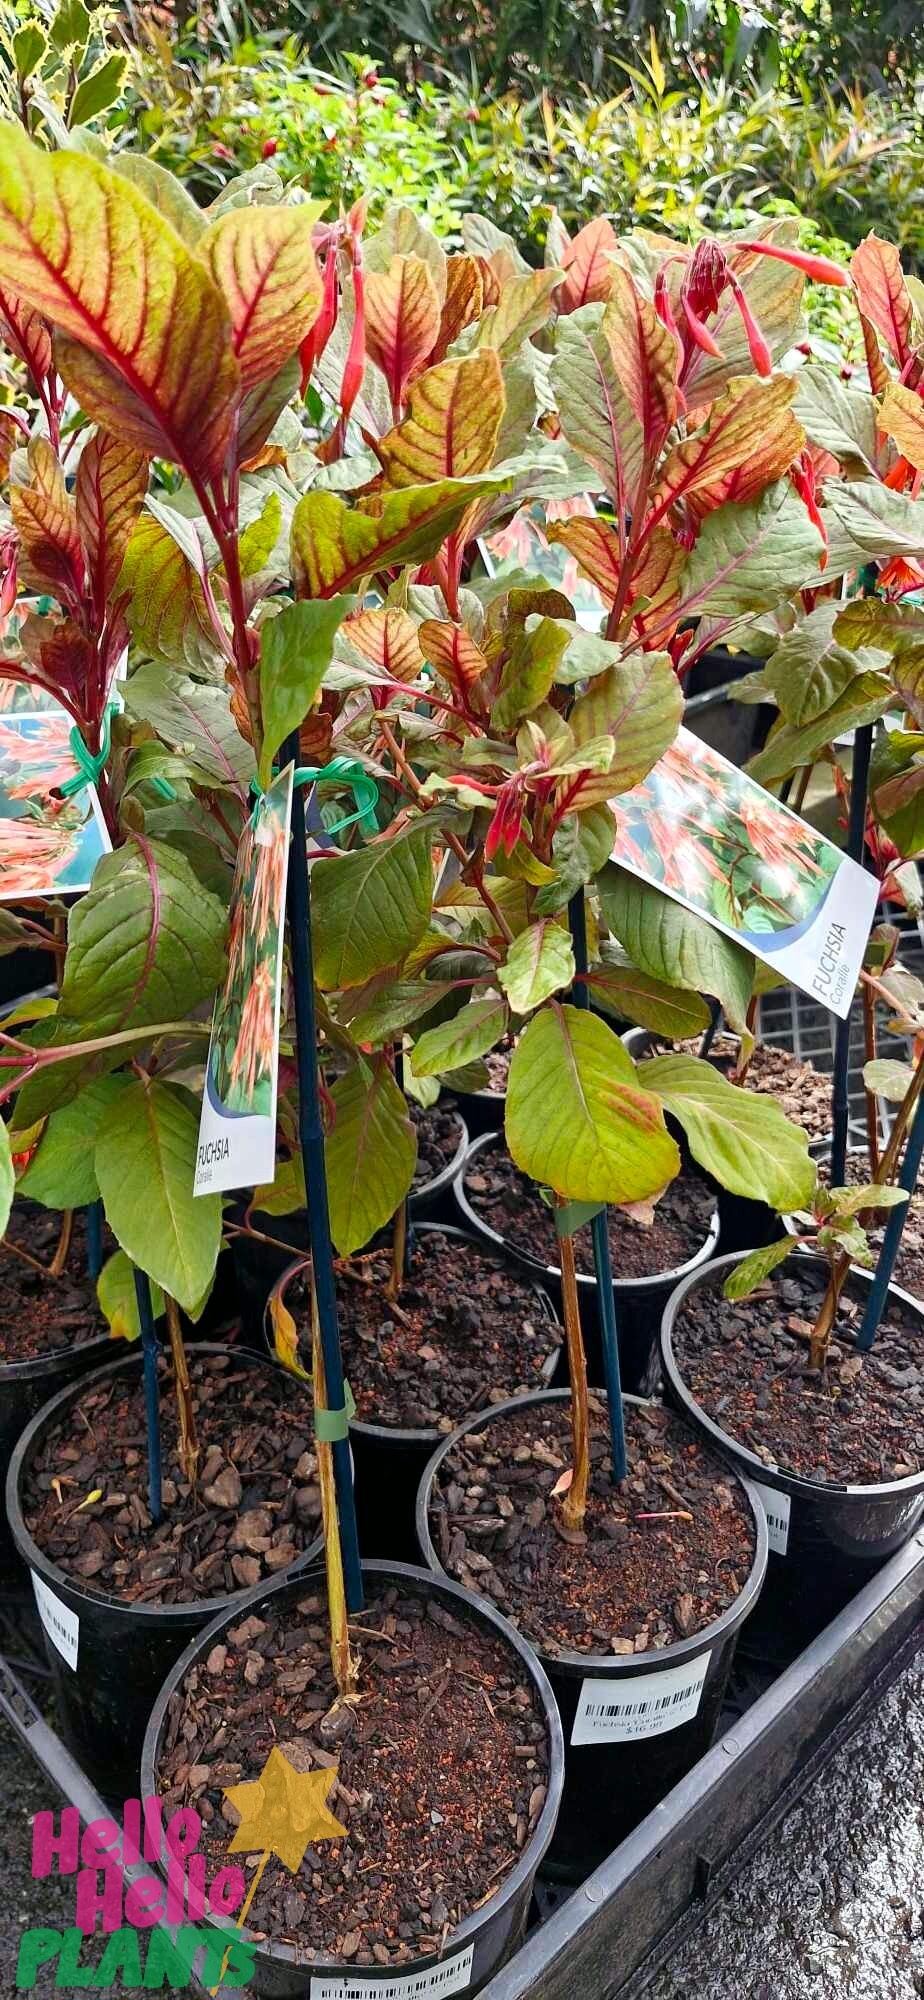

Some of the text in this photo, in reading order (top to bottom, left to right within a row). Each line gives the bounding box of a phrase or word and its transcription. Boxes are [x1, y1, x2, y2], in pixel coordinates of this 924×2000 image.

[812, 922, 846, 997] FUCHSIA
[830, 963, 850, 1005] Coralle
[198, 1137, 230, 1166] FUCHSIA
